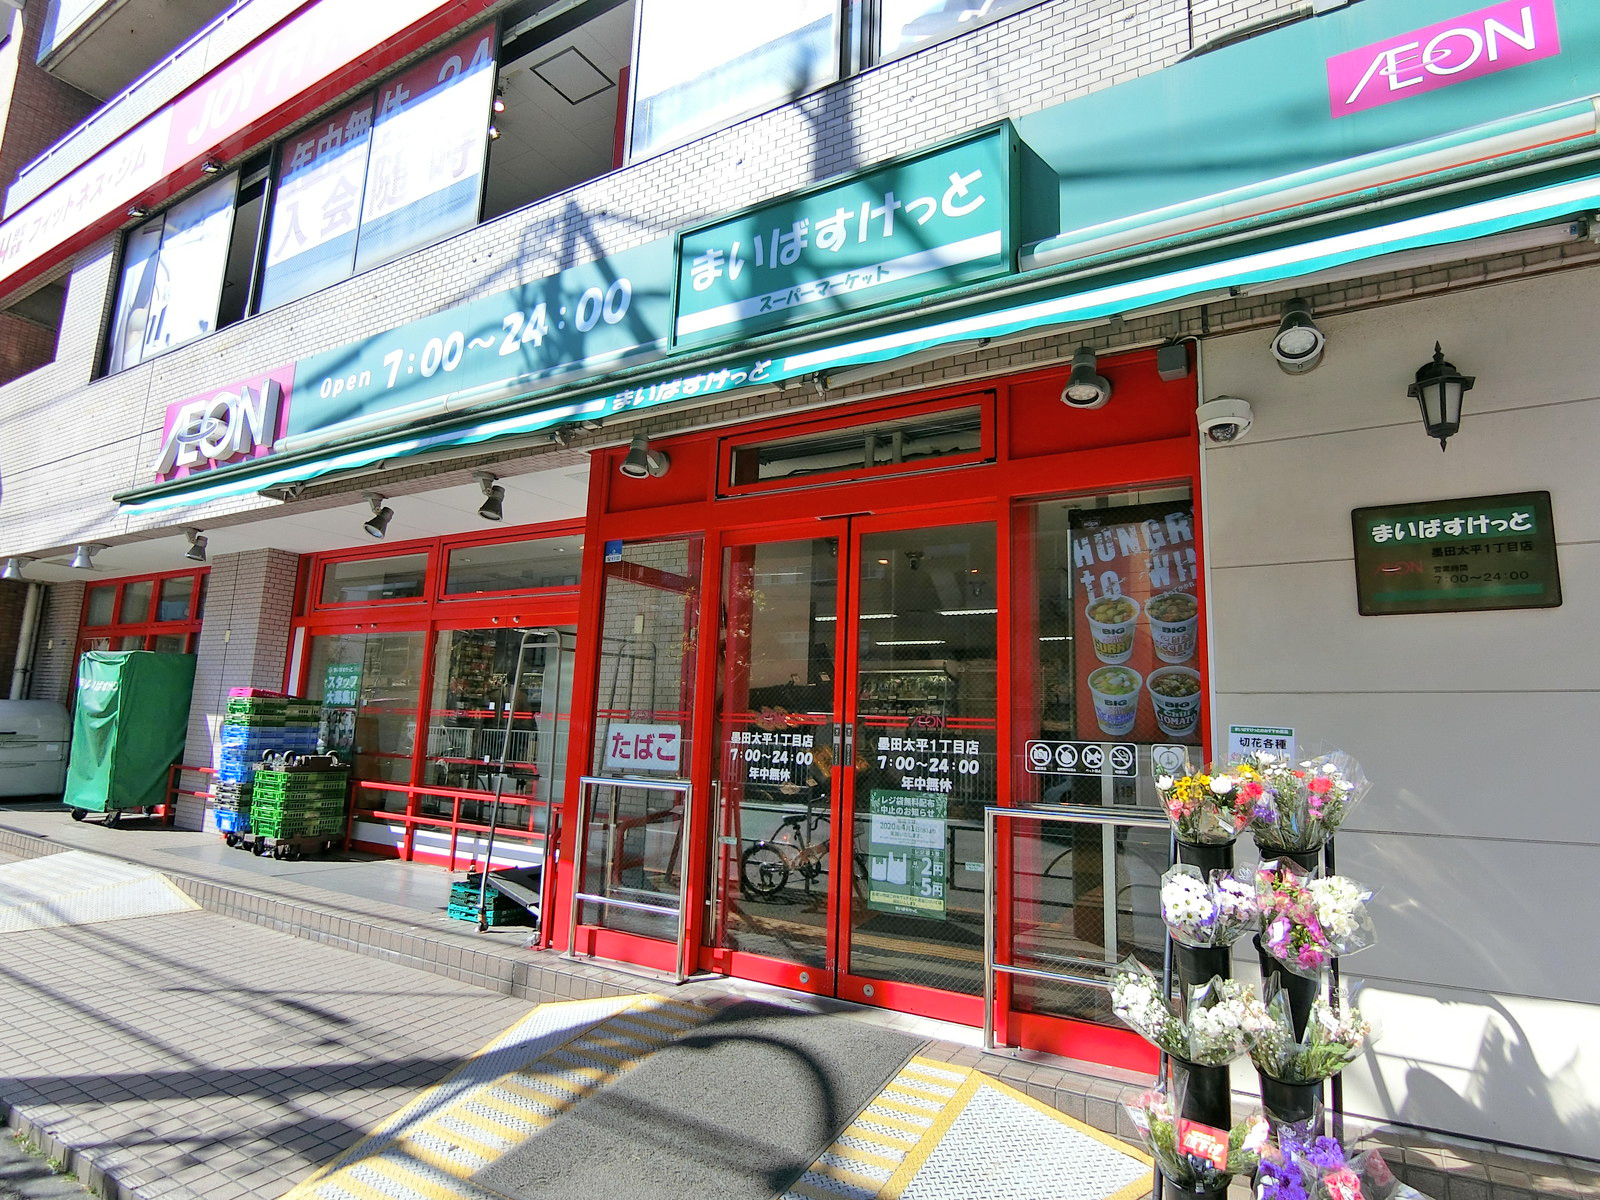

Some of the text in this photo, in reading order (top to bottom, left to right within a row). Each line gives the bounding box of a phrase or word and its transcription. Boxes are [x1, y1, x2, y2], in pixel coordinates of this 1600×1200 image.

[690, 169, 987, 292] まいばすけっと
[759, 265, 891, 313] スーパーマーケット
[319, 369, 372, 399] Open
[612, 358, 772, 411] まいばすけっと
[1073, 505, 1194, 568] HUNGR
[1371, 512, 1533, 543] まいばすけっと
[1431, 541, 1534, 558] 墨田太平1丁目店
[612, 732, 676, 761] たばこ
[731, 732, 814, 748] 墨田太平1丁目店
[878, 737, 979, 755] 墨田太平1丁目店
[1239, 736, 1287, 750] 切花各種
[749, 766, 791, 782] 年中無休
[901, 776, 952, 792] 年中無休
[880, 806, 935, 817] 中止のお知らせ
[881, 796, 935, 808] レジ袋無料配布
[921, 857, 944, 877] 2円
[920, 877, 943, 897] 5円
